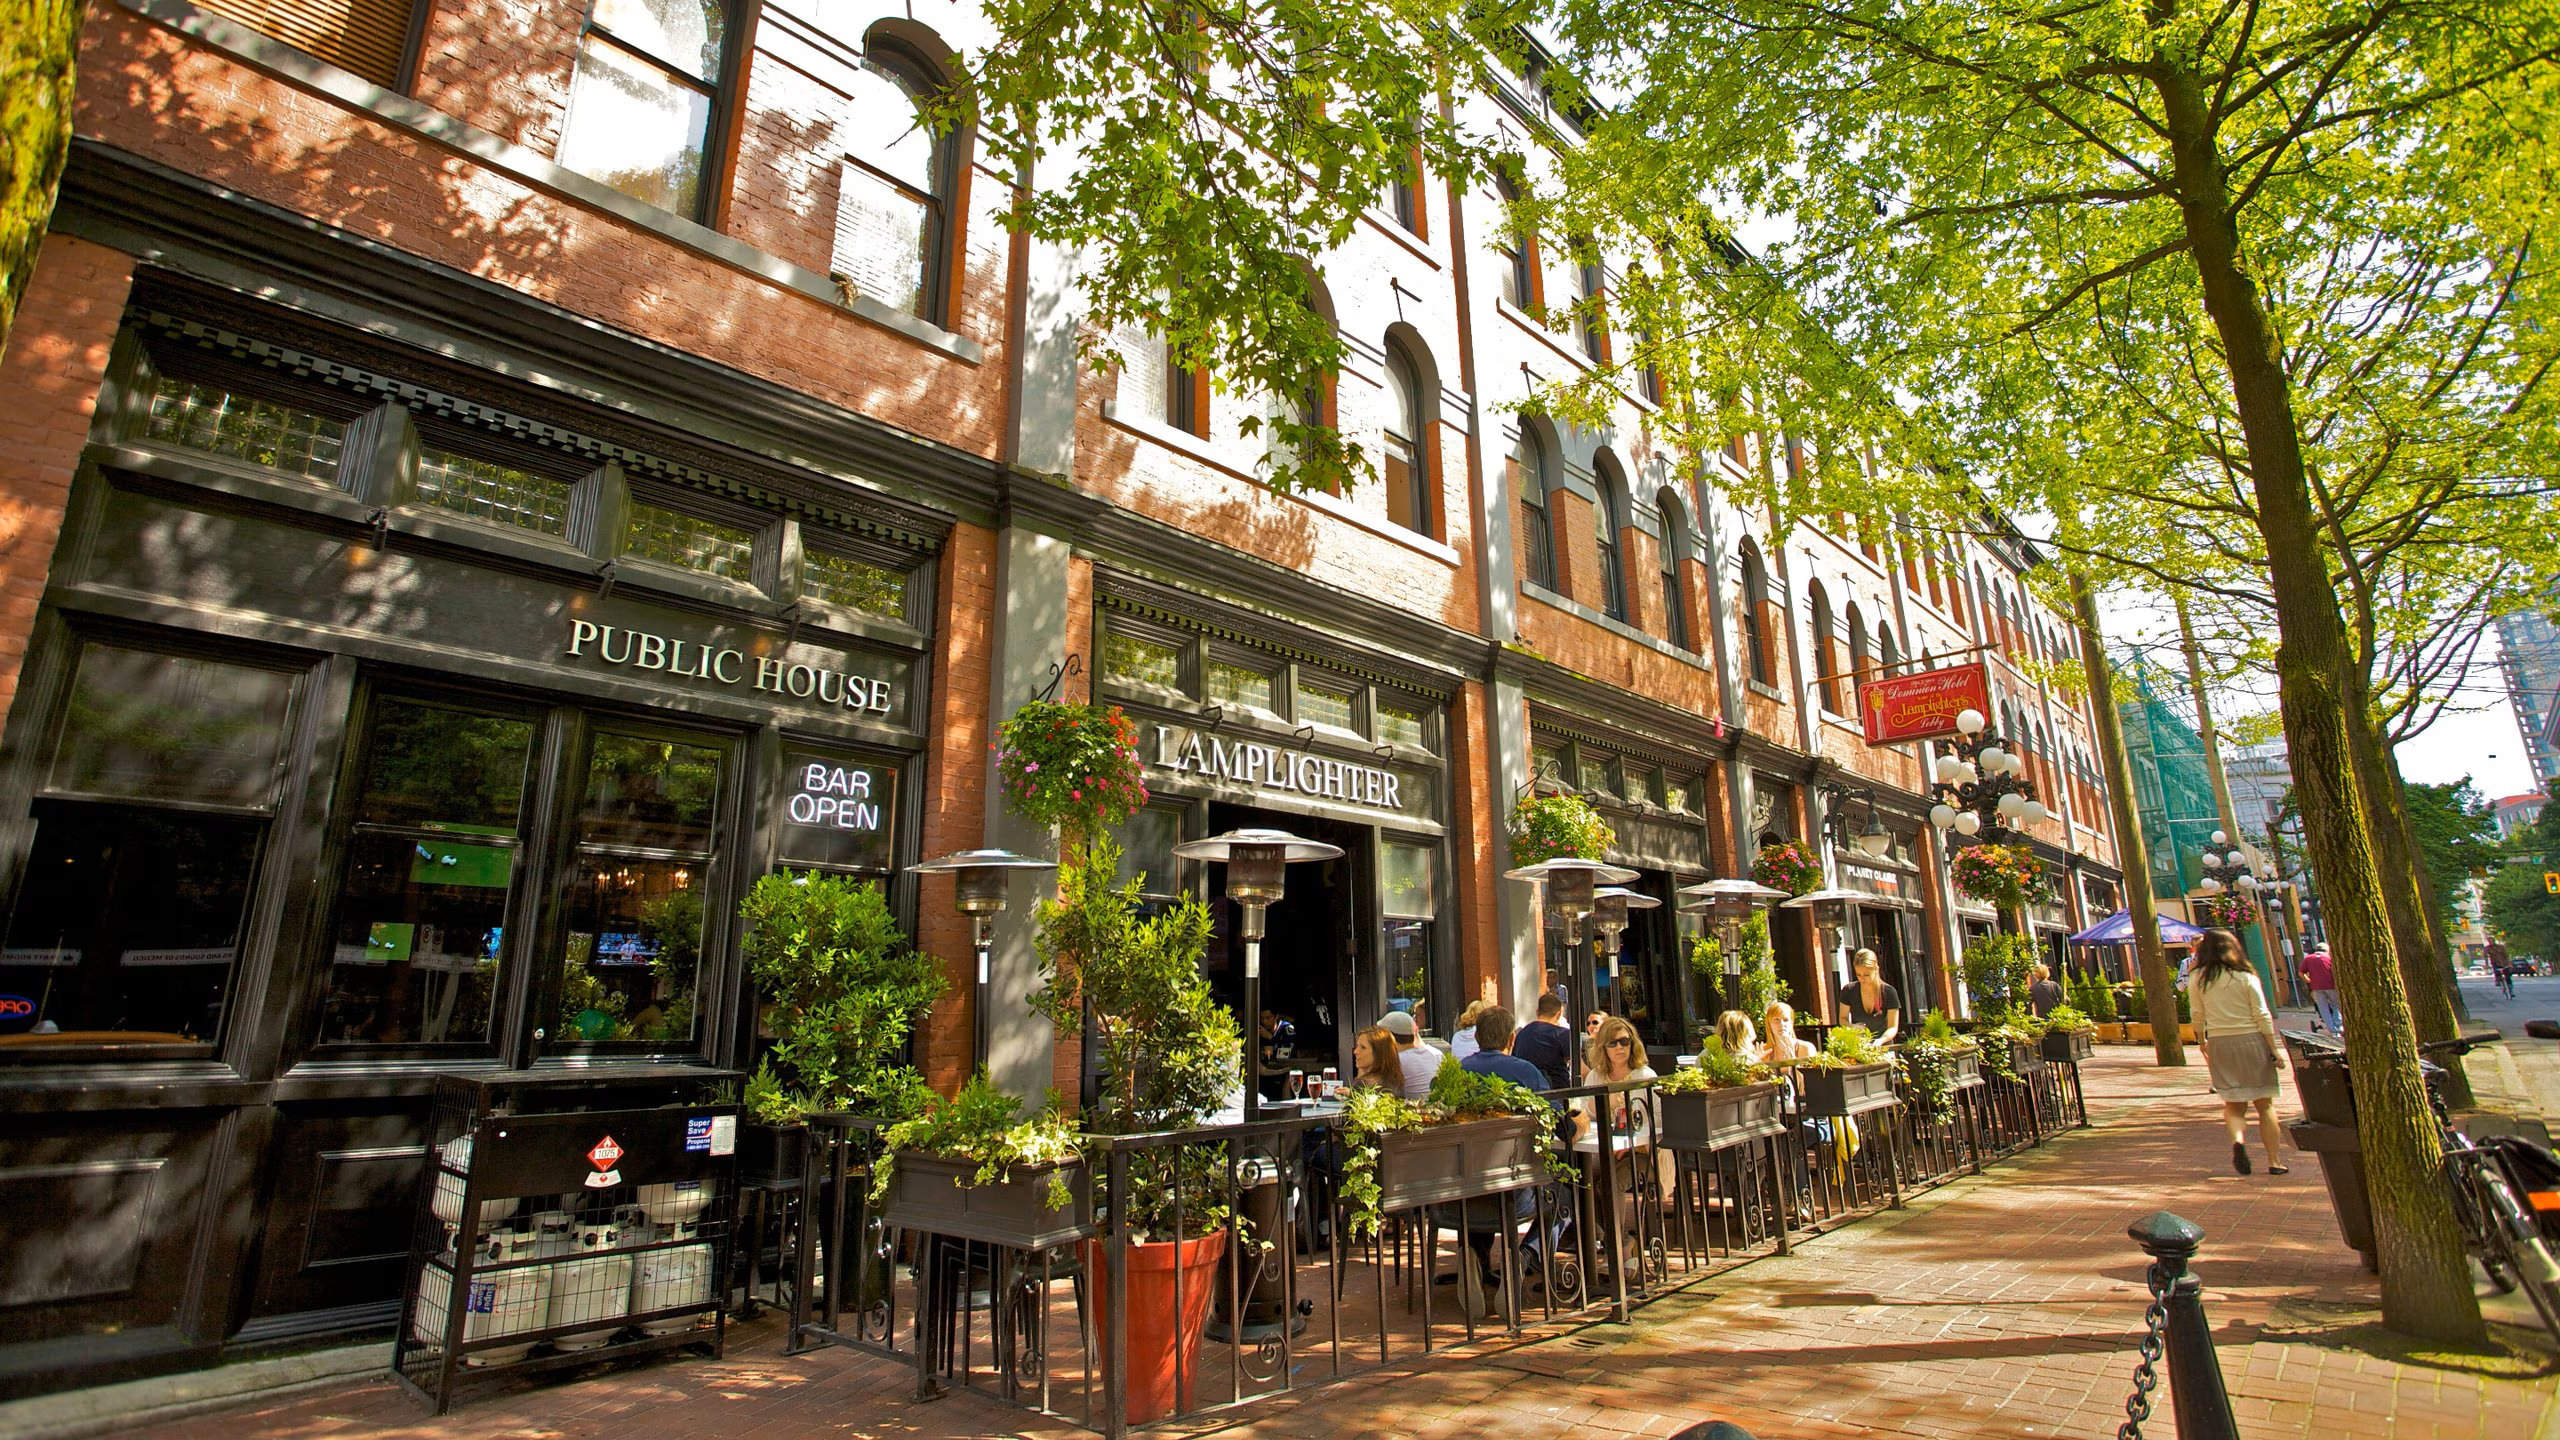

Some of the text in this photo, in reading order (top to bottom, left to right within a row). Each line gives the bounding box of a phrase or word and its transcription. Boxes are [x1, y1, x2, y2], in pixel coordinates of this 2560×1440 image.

[565, 618, 892, 713] PUBLIC HOUSE
[1887, 683, 1937, 699] Dominion
[1938, 674, 1971, 691] Hotel
[1920, 718, 1945, 730] Lobby
[804, 763, 871, 798] BAR
[1153, 725, 1403, 809] LAMPLIGHTER
[789, 792, 879, 831] OPEN
[687, 1119, 711, 1128] Super
[597, 1149, 616, 1158] 1075
[483, 1284, 495, 1311] Super
